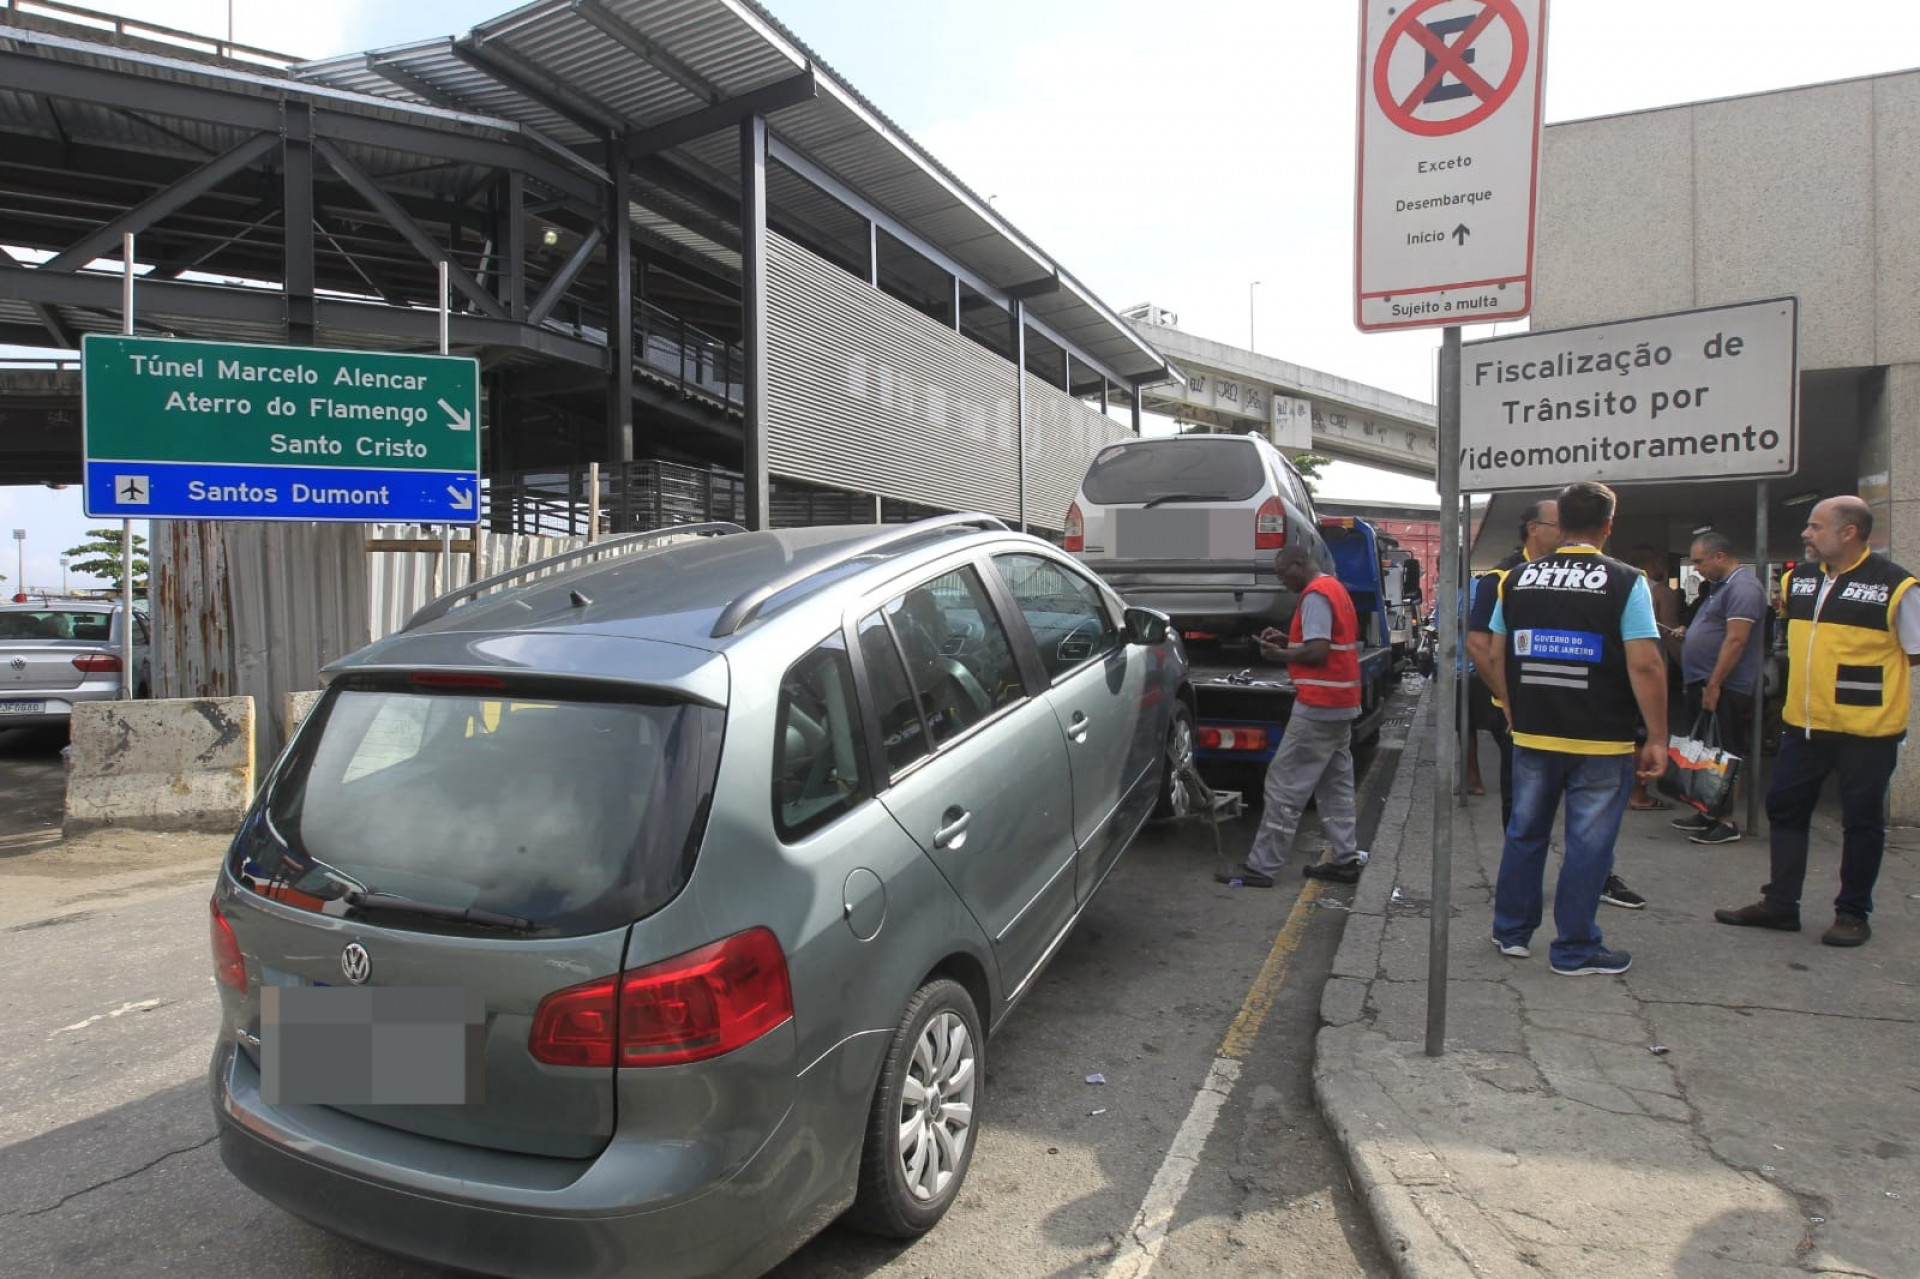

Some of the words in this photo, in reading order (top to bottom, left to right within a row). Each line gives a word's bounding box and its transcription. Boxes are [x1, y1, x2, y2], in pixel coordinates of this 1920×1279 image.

[1418, 156, 1472, 173] Exceto
[1396, 189, 1493, 212] Desembarque
[1391, 302, 1440, 318] Sujeito
[1444, 301, 1452, 311] a
[1456, 295, 1498, 310] multa
[1475, 341, 1672, 386] Fiscalização
[1703, 332, 1744, 359] de
[129, 354, 203, 378] Túnel
[217, 360, 318, 384] Marcelo
[333, 367, 427, 391] Alencar
[164, 391, 251, 414] Aterro
[266, 396, 296, 416] do
[310, 397, 428, 427] Flamengo
[1502, 391, 1637, 424] Trânsito
[1651, 386, 1709, 419] por
[270, 433, 342, 455] Santo
[356, 437, 427, 458] Cristo
[188, 480, 278, 503] Santos
[292, 483, 389, 505] Dumont
[1533, 644, 1547, 652] RIO
[1549, 645, 1559, 653] DE
[1561, 646, 1594, 656] JANEIRO
[1534, 634, 1569, 645] GOVERNO
[1571, 637, 1583, 645] DO
